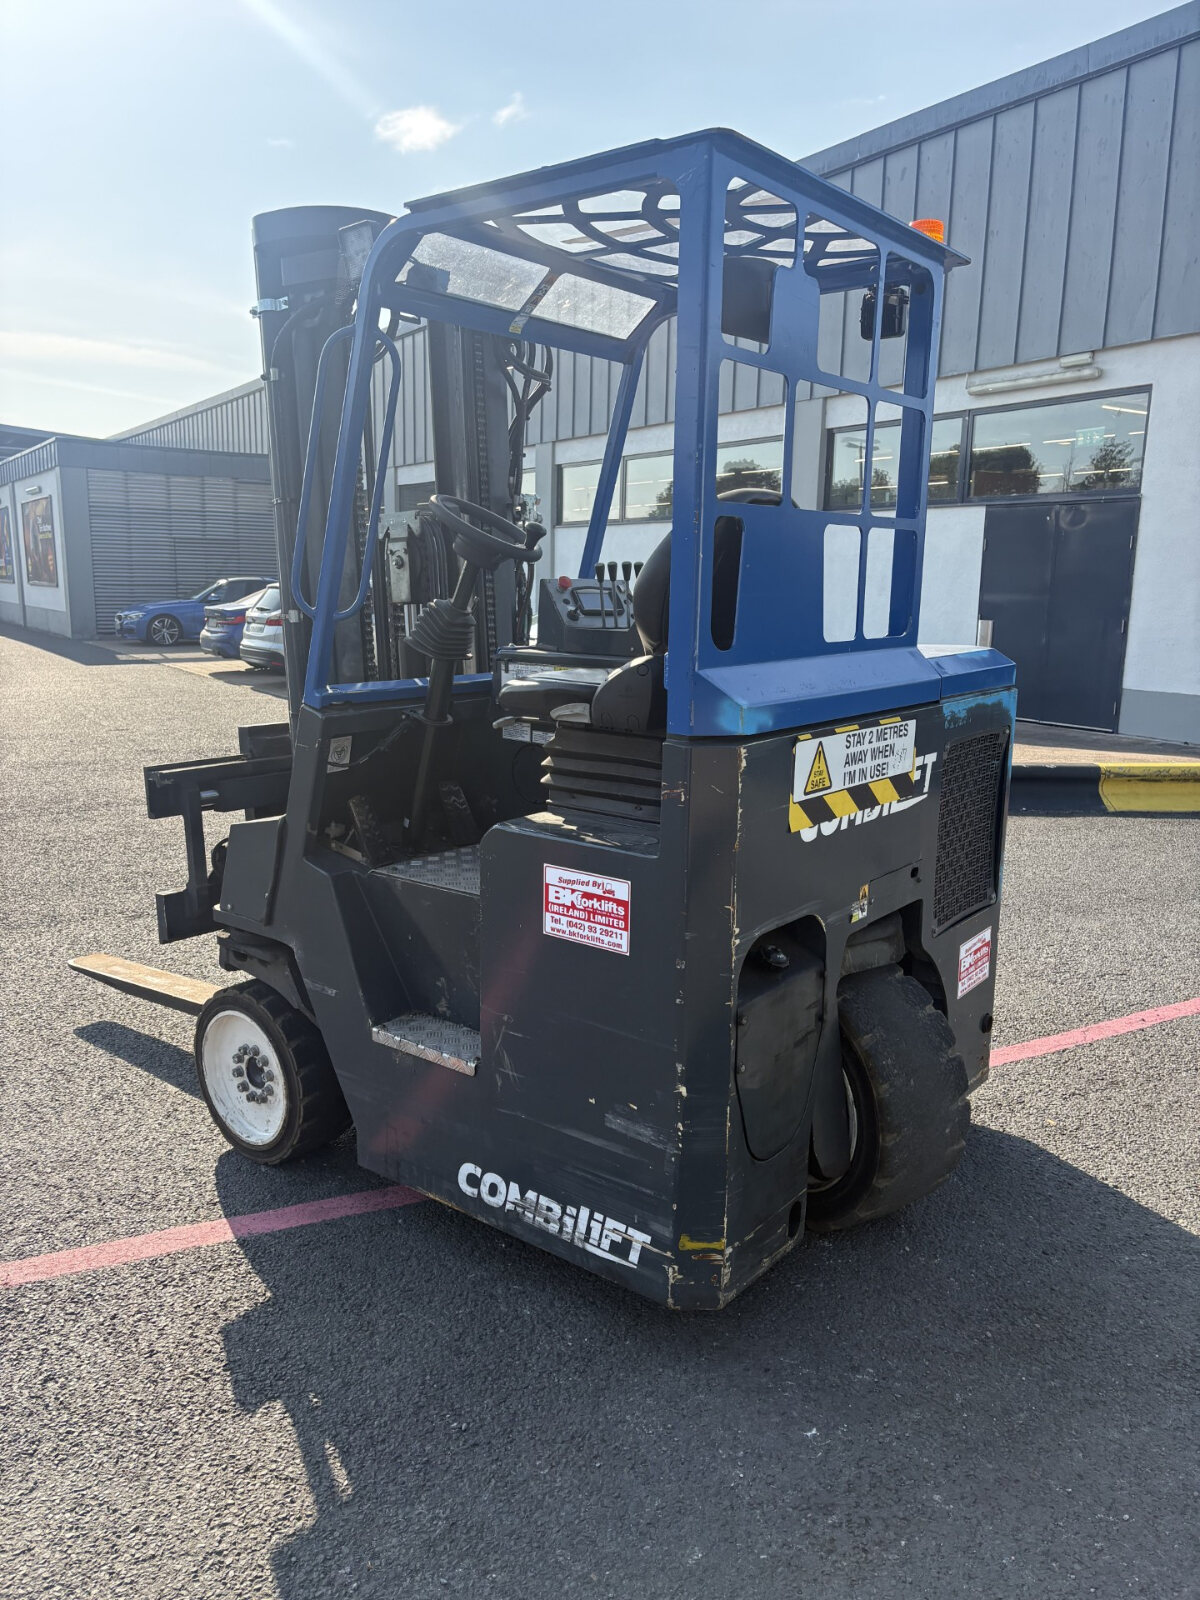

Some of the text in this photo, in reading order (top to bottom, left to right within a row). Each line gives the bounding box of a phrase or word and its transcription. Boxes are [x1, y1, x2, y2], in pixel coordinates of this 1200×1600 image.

[845, 723, 909, 749] STAY 2 METRES
[843, 742, 896, 768] AWAY WHEN
[810, 777, 826, 789] SAFE
[843, 761, 889, 786] I'M IN USE!
[558, 876, 590, 887] Supplied
[548, 902, 588, 920] (IRELAND)
[590, 914, 625, 929] LIMITED
[550, 916, 623, 940] Tel. (042) 93 29211
[550, 926, 623, 949] www.bkforklifts.com
